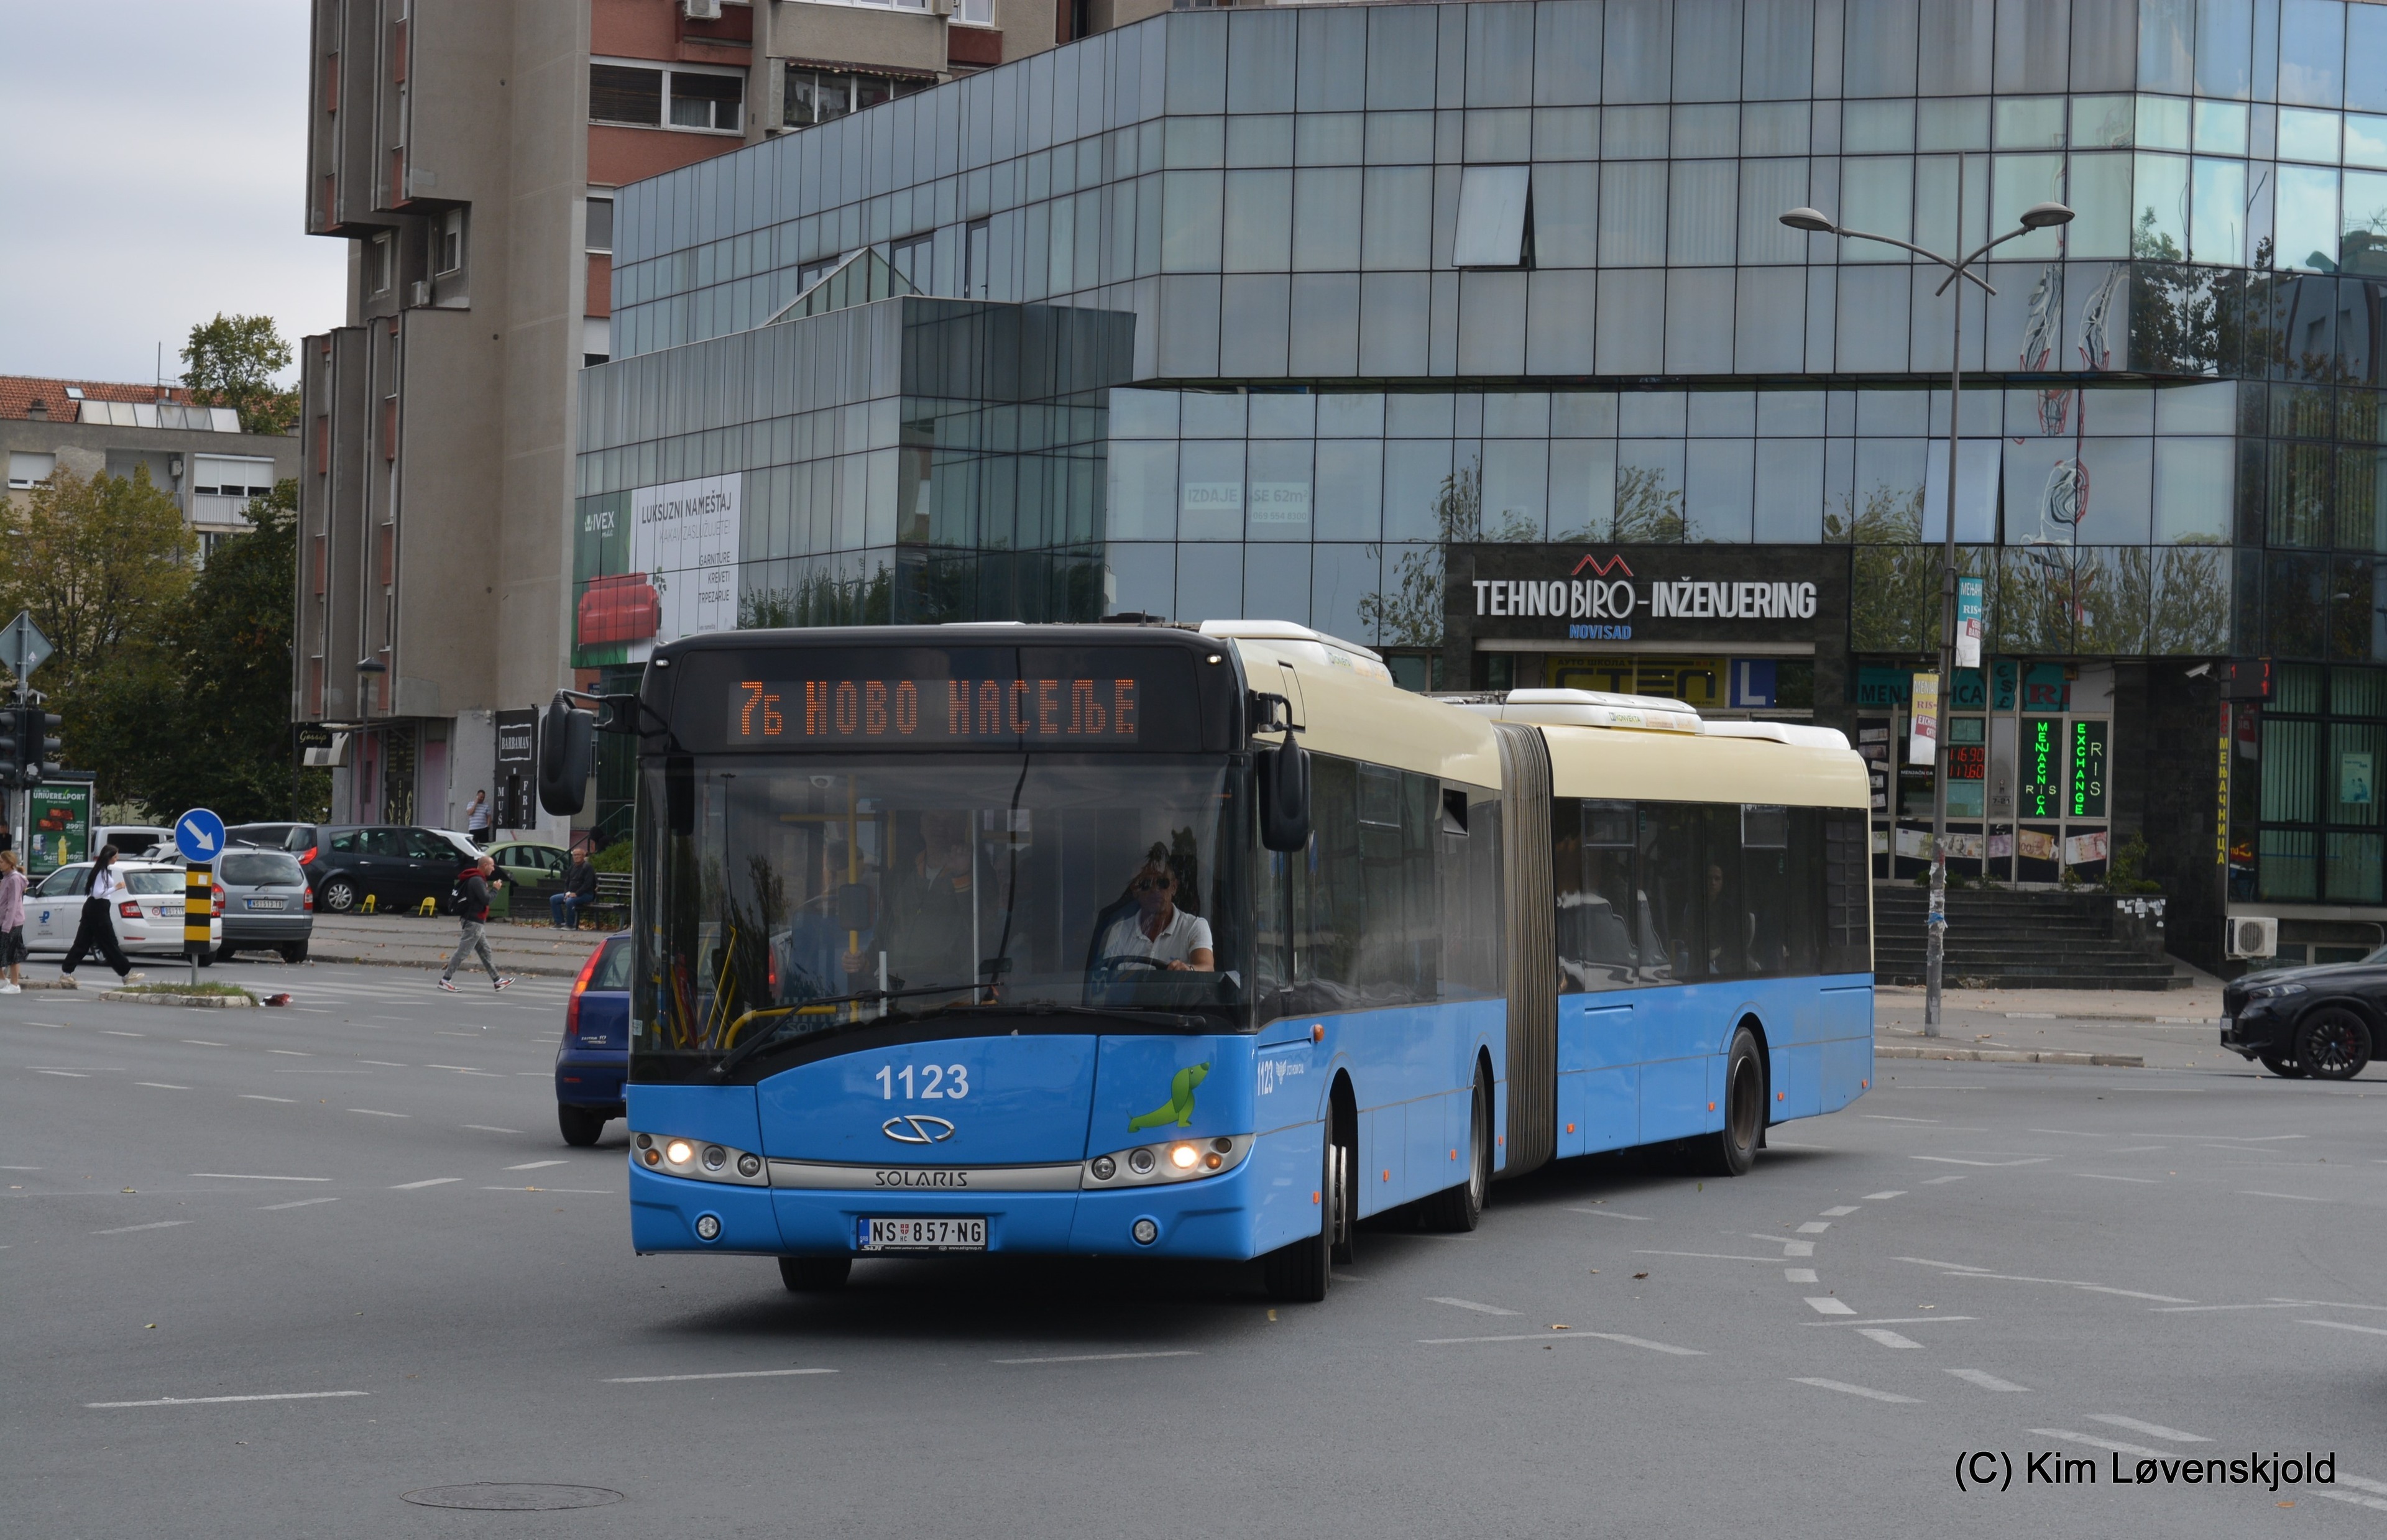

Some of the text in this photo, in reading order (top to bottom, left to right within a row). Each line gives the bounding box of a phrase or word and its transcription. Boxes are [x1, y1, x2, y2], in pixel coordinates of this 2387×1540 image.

[1188, 488, 1238, 503] IZDAJE
[1254, 489, 1269, 502] SE
[642, 490, 732, 524] LUKSUZNI NAMEŠTAJ
[592, 511, 615, 531] IVEX
[1253, 512, 1307, 520] 069 554 8300
[659, 529, 680, 544] KAKAV
[699, 551, 730, 566] GARNITURE
[707, 571, 730, 584] KREVETI
[698, 589, 730, 604] TRPEZARIJE
[1739, 662, 1766, 705] L
[806, 681, 917, 735] НОВО
[949, 679, 1134, 734] НАСЕЉЕ
[1616, 715, 1641, 723] KONVEKTA
[299, 730, 327, 744] Gossip
[501, 735, 530, 750] BARBAMAN
[2074, 723, 2086, 815] EXCHANGE
[33, 789, 86, 801] UNIVEREXPORT
[2217, 737, 2228, 865] МЕЊАЧНИЦА
[875, 1064, 969, 1100] 1123
[1258, 1060, 1273, 1096] 1123
[875, 1171, 968, 1187] SOLARIS
[873, 1222, 896, 1242] NS
